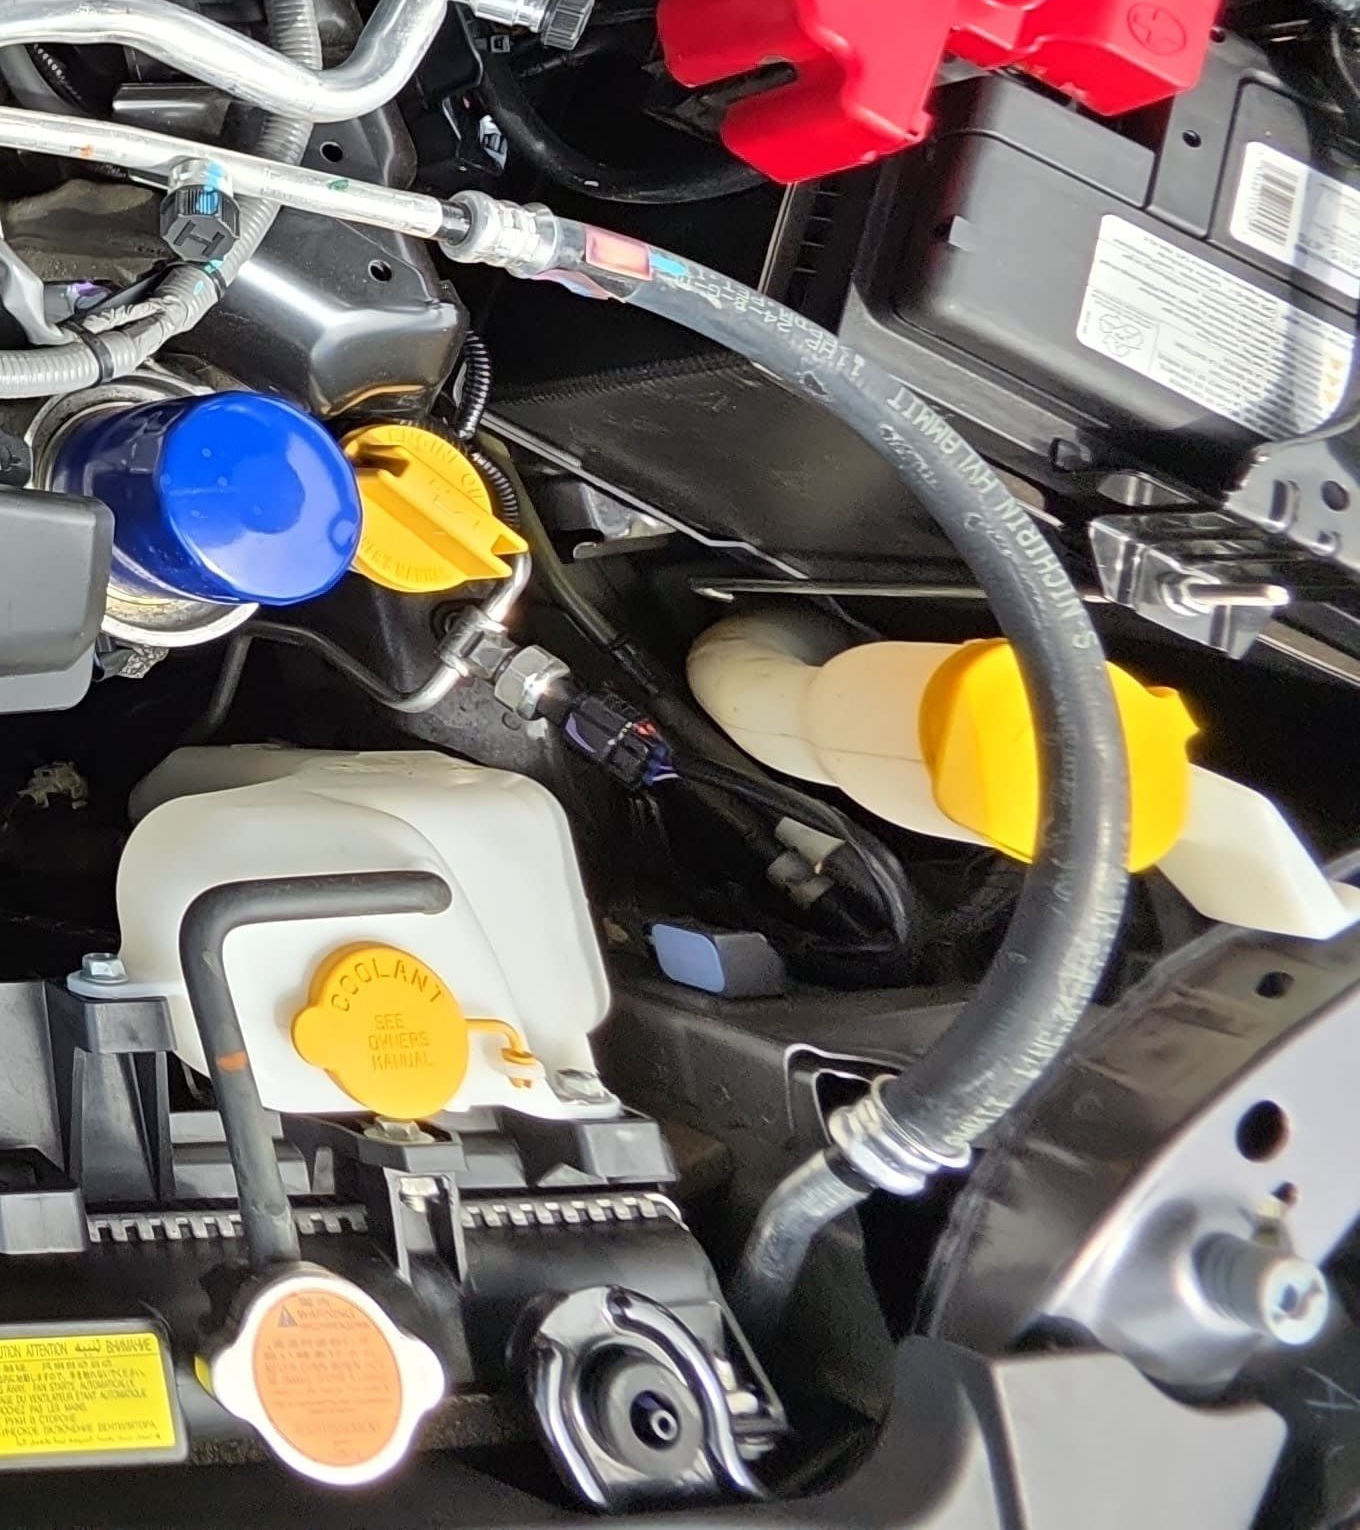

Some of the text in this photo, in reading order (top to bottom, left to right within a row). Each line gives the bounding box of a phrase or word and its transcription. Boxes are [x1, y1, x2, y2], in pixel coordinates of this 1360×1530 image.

[173, 220, 225, 257] H
[331, 958, 445, 1012] COOLANT
[374, 1013, 406, 1030] SEE
[26, 1341, 69, 1357] ATTENTION
